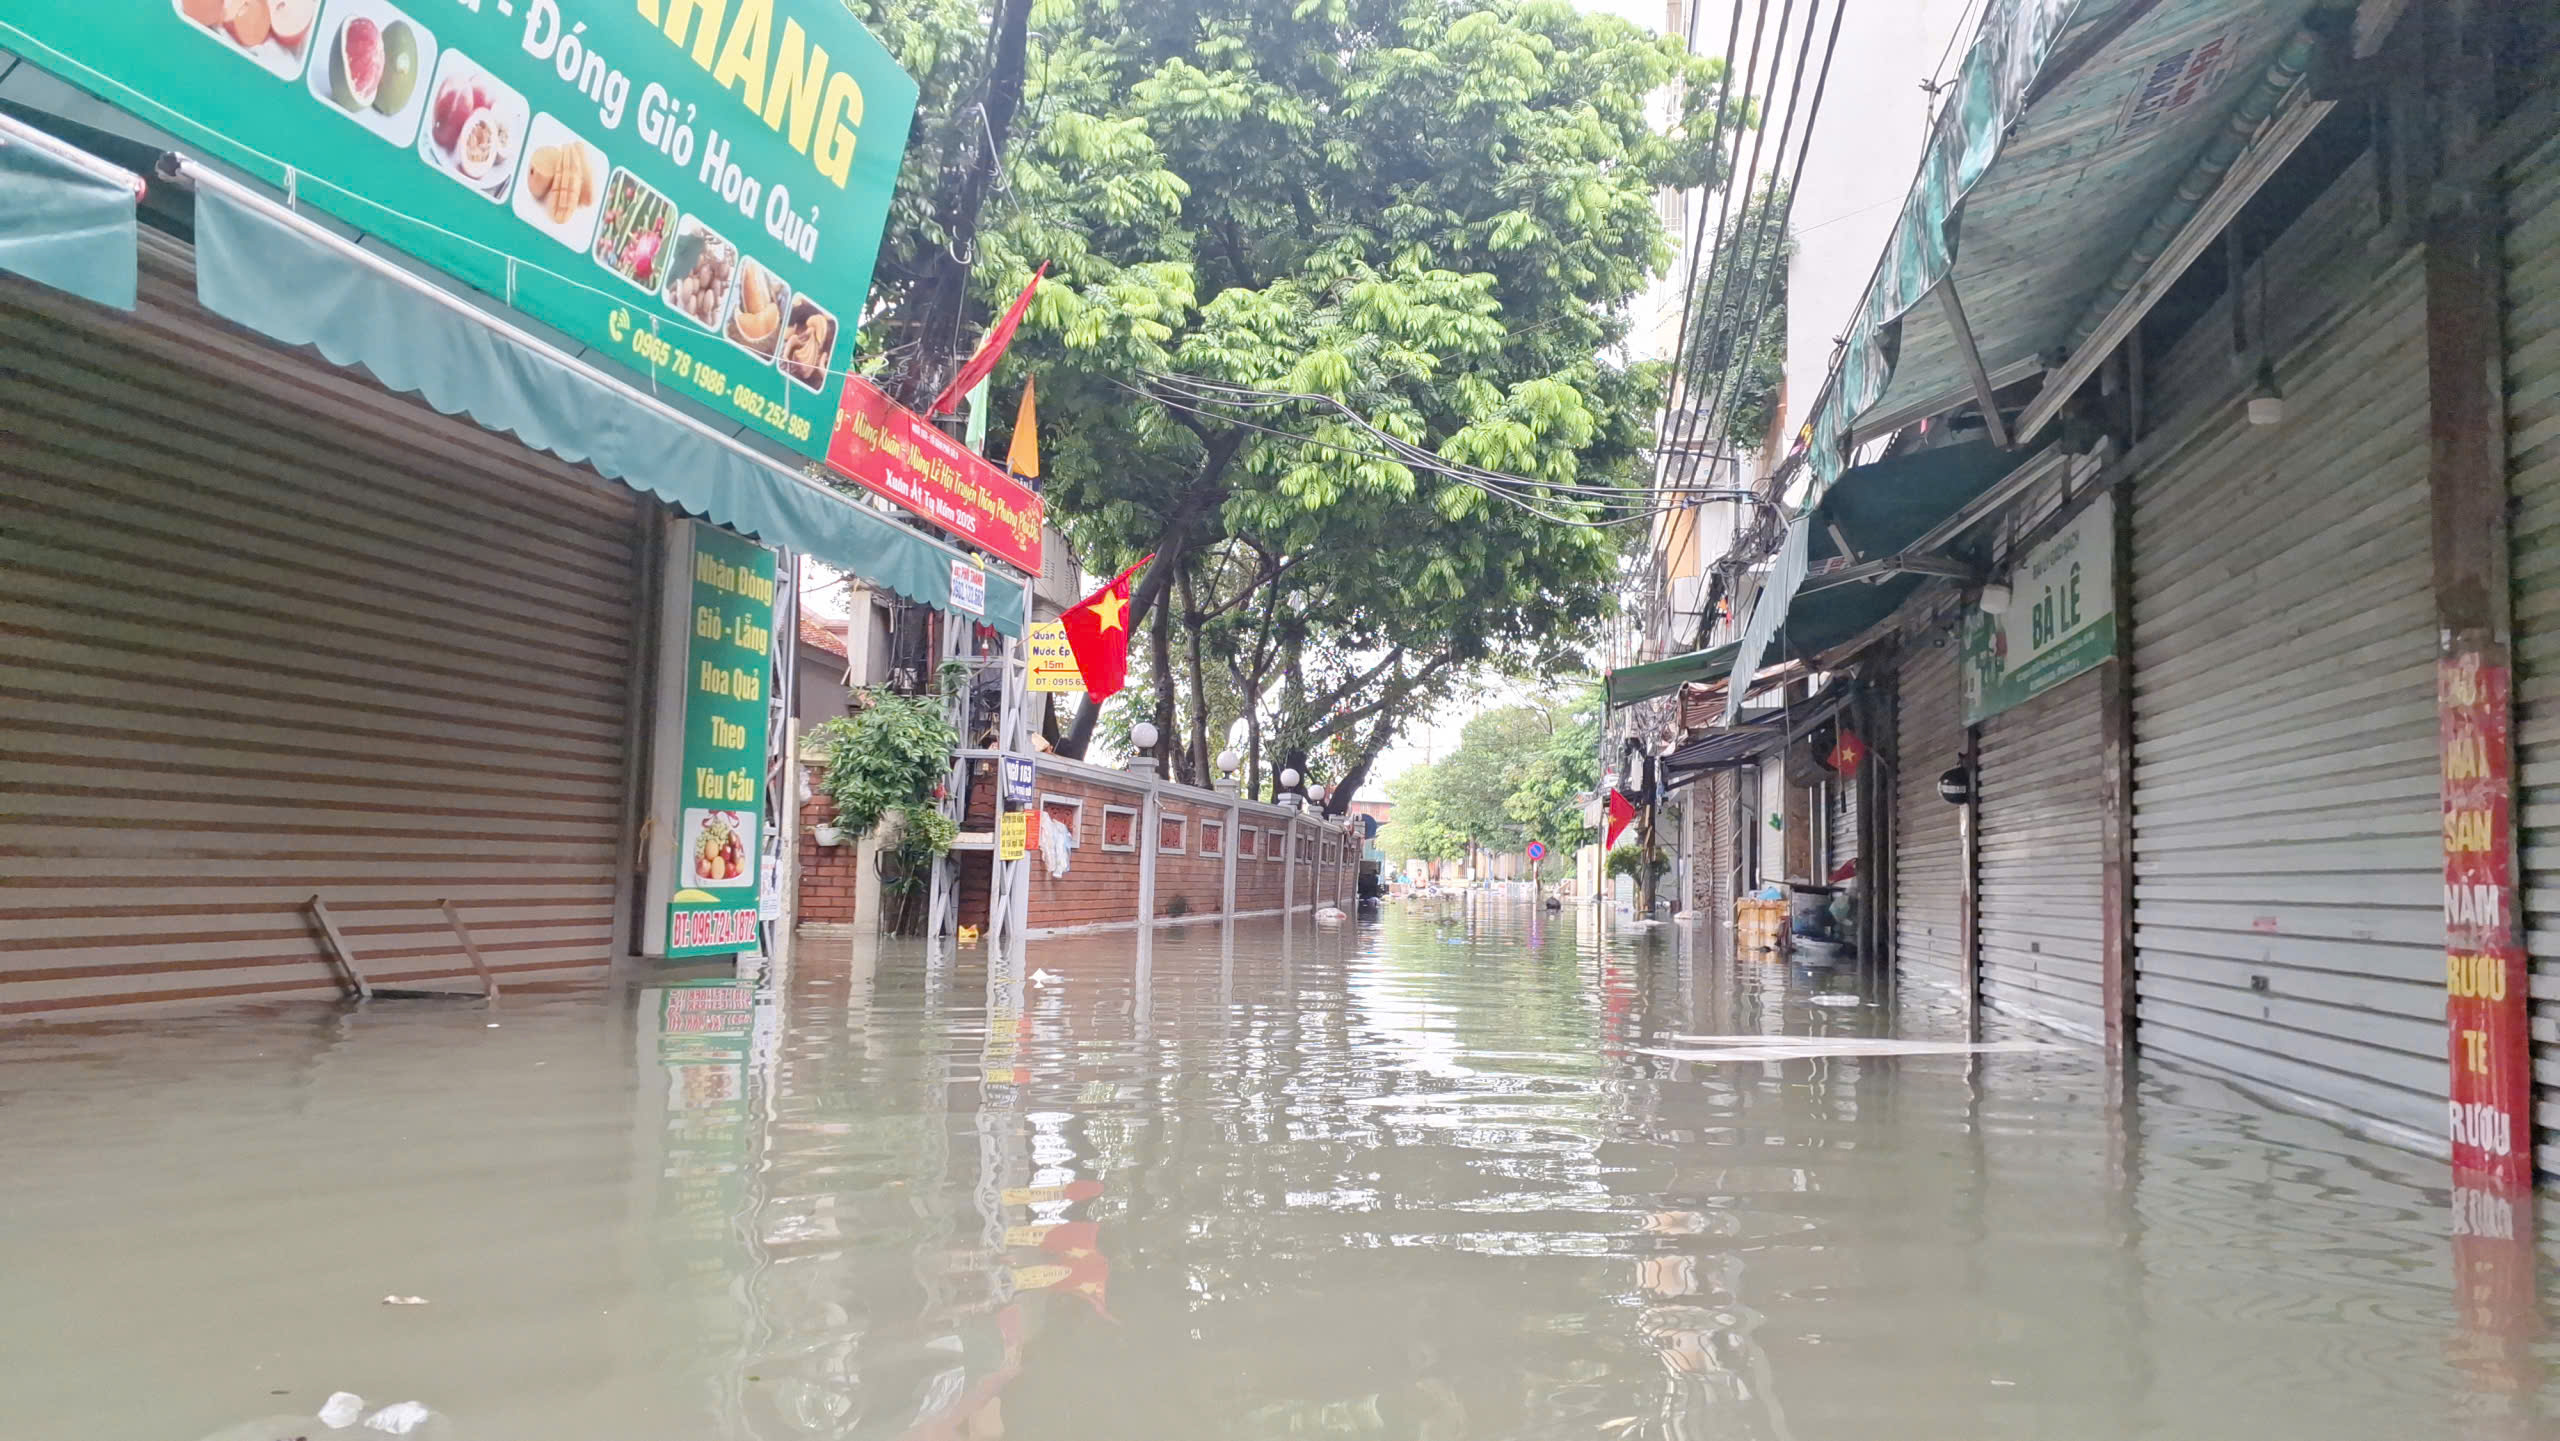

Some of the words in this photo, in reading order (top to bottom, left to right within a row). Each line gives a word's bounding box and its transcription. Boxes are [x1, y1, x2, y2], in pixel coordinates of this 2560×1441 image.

[522, 0, 630, 130] Đóng
[637, 82, 698, 167] Giỏ
[698, 129, 761, 220] Hoa
[764, 184, 819, 265] Quả
[632, 328, 671, 366] 0965
[672, 349, 692, 377] 78
[693, 362, 727, 396] 1986
[733, 384, 766, 418] 0862
[764, 399, 788, 431] 252
[788, 415, 811, 441] 988
[878, 426, 900, 459] Xuân
[940, 464, 954, 493] Hội
[956, 508, 976, 533] 2025
[696, 551, 735, 595] Nhận
[738, 566, 773, 607] Đóng
[696, 605, 722, 641] Giỏ
[1032, 646, 1056, 656] Nước
[1058, 643, 1071, 659] Ép
[1044, 660, 1064, 669] 15m
[700, 660, 729, 695] Hoa
[733, 668, 760, 702] Quả
[1052, 678, 1074, 686] 0915
[711, 715, 746, 750] Theo
[696, 767, 724, 800] Yêu
[727, 767, 755, 802] Cầu
[691, 908, 757, 948] 096.724.1872
